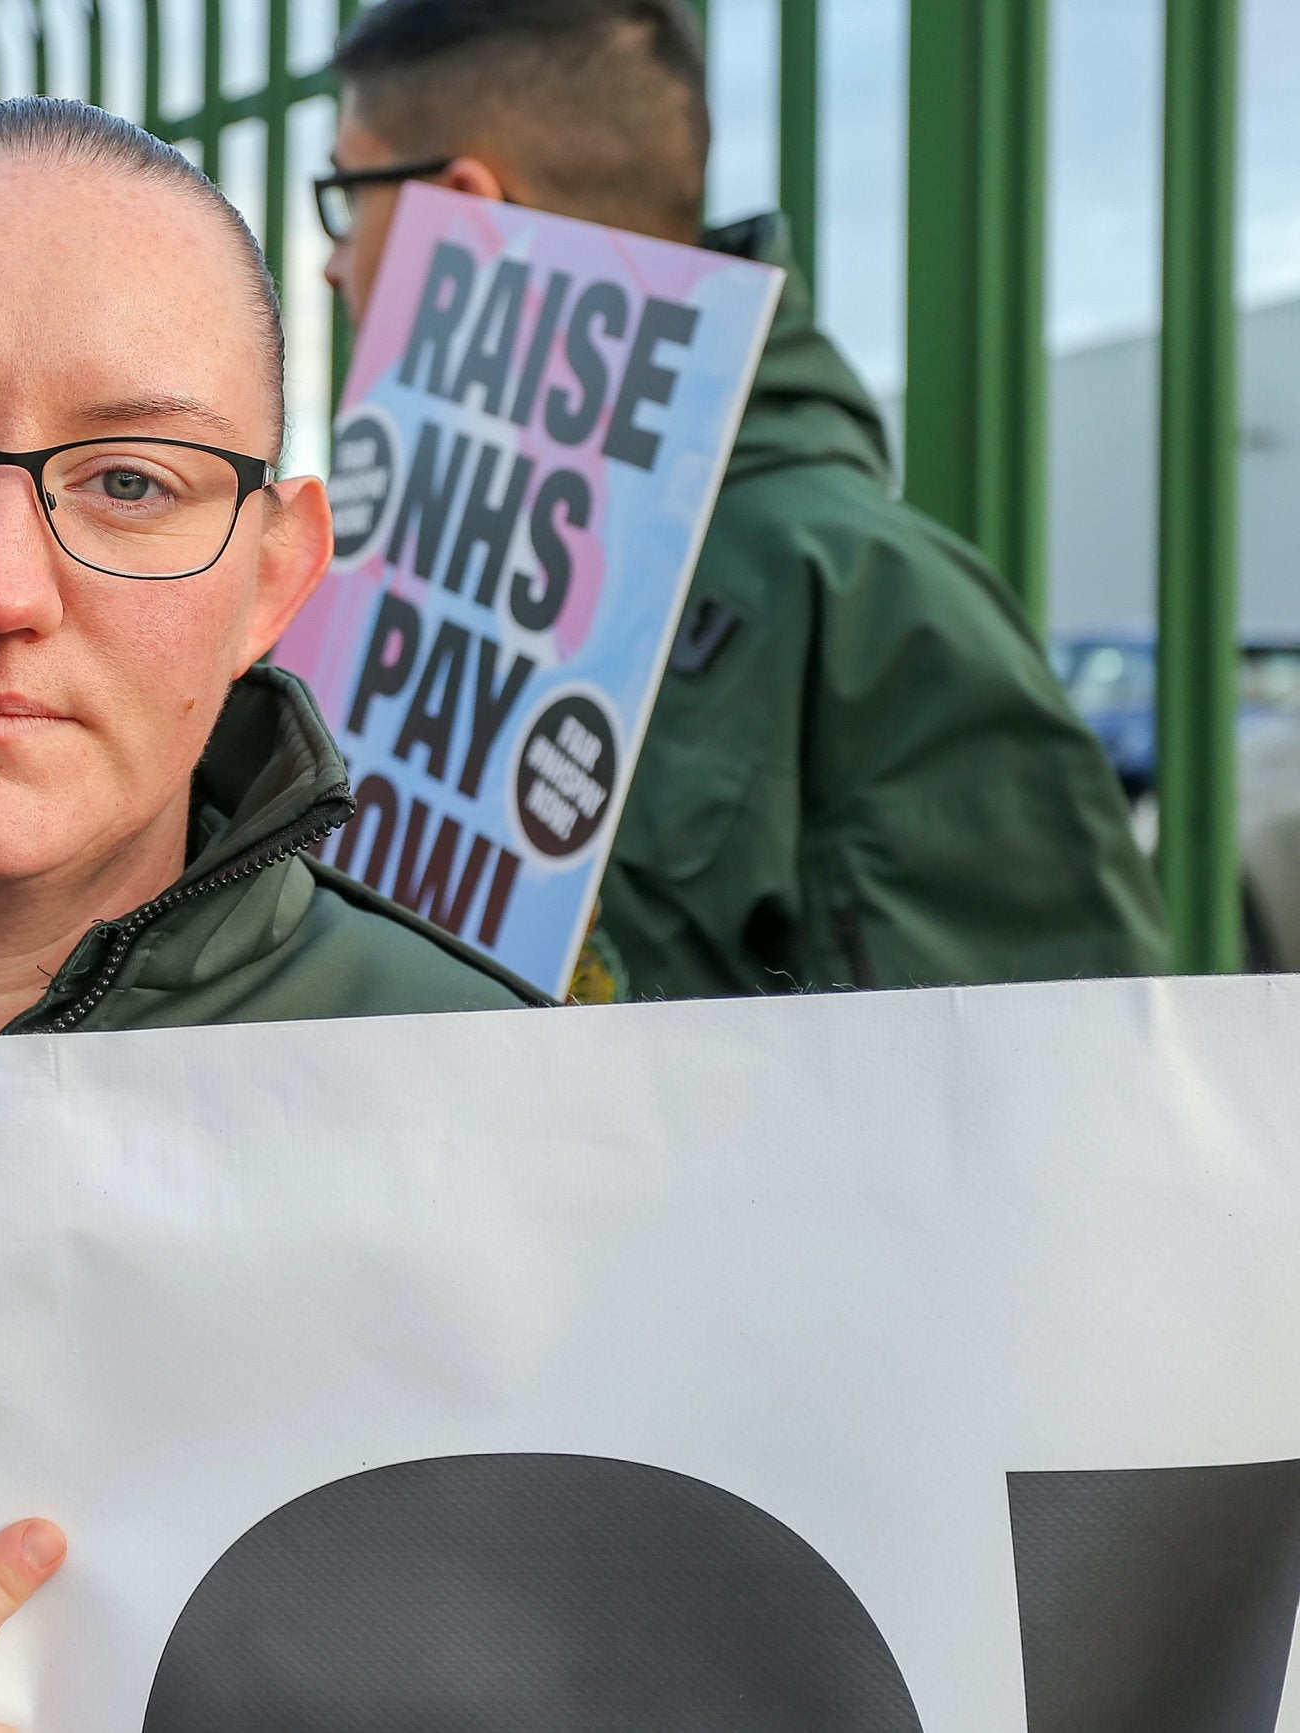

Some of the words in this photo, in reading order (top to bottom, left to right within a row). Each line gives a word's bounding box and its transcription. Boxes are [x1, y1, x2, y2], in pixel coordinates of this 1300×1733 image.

[398, 240, 702, 473] RAISE
[386, 421, 592, 632] NHS
[348, 591, 537, 799] PAY
